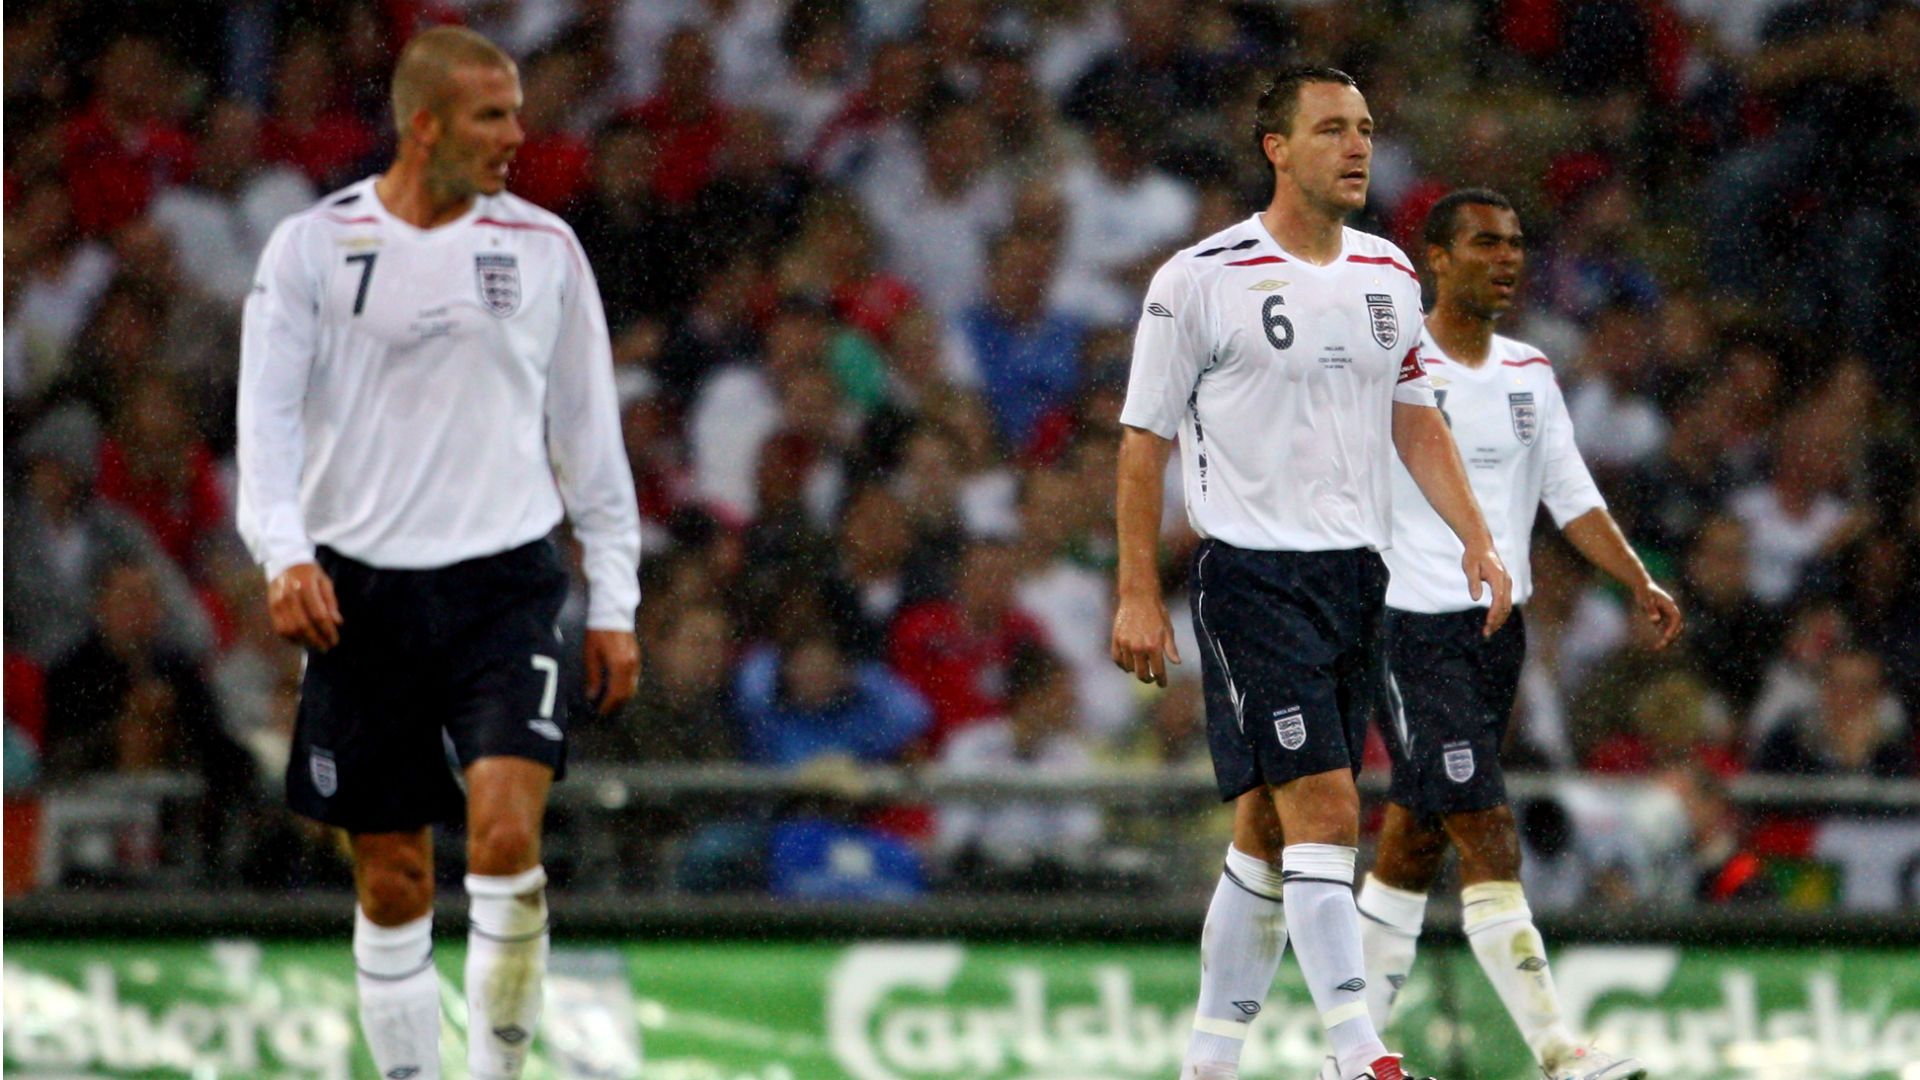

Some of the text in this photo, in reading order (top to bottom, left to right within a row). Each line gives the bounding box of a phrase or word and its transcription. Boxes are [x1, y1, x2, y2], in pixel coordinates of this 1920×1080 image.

[345, 252, 378, 316] 7
[1261, 294, 1295, 350] 6
[530, 653, 559, 718] 7
